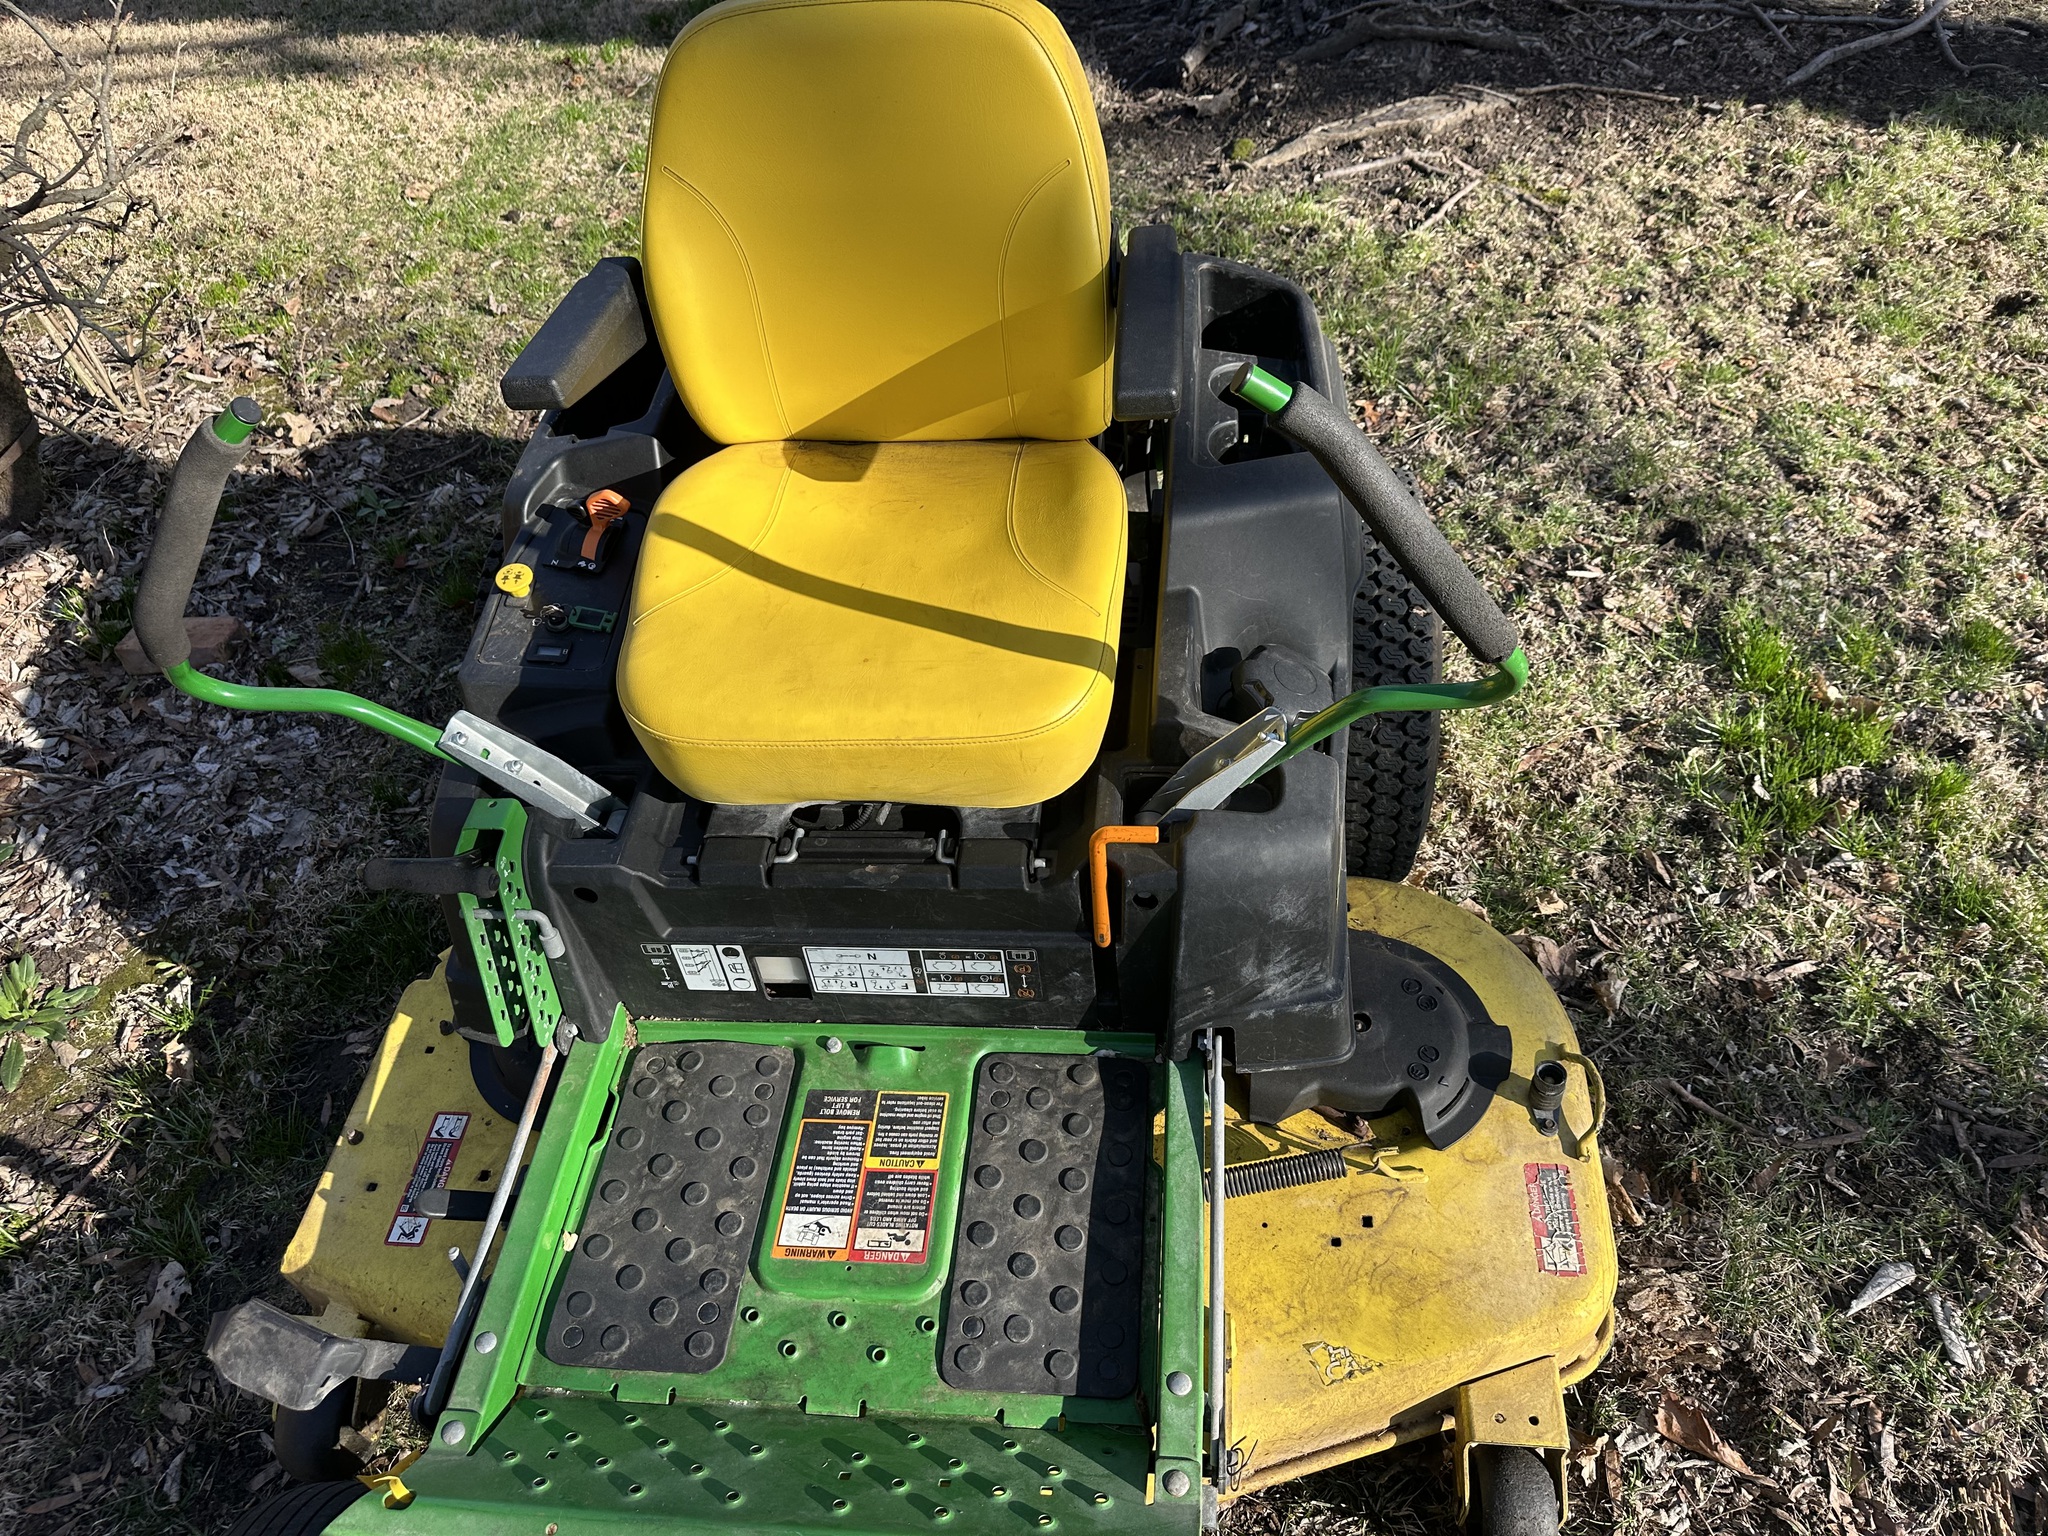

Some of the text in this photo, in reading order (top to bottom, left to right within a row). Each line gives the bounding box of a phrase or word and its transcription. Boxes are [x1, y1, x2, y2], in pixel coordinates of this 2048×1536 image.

[879, 1159, 915, 1167] CAUTION
[437, 1167, 450, 1188] DANG
[1528, 1184, 1540, 1213] DANGER
[784, 1248, 826, 1258] WARNING
[864, 1251, 900, 1261] DANGER
